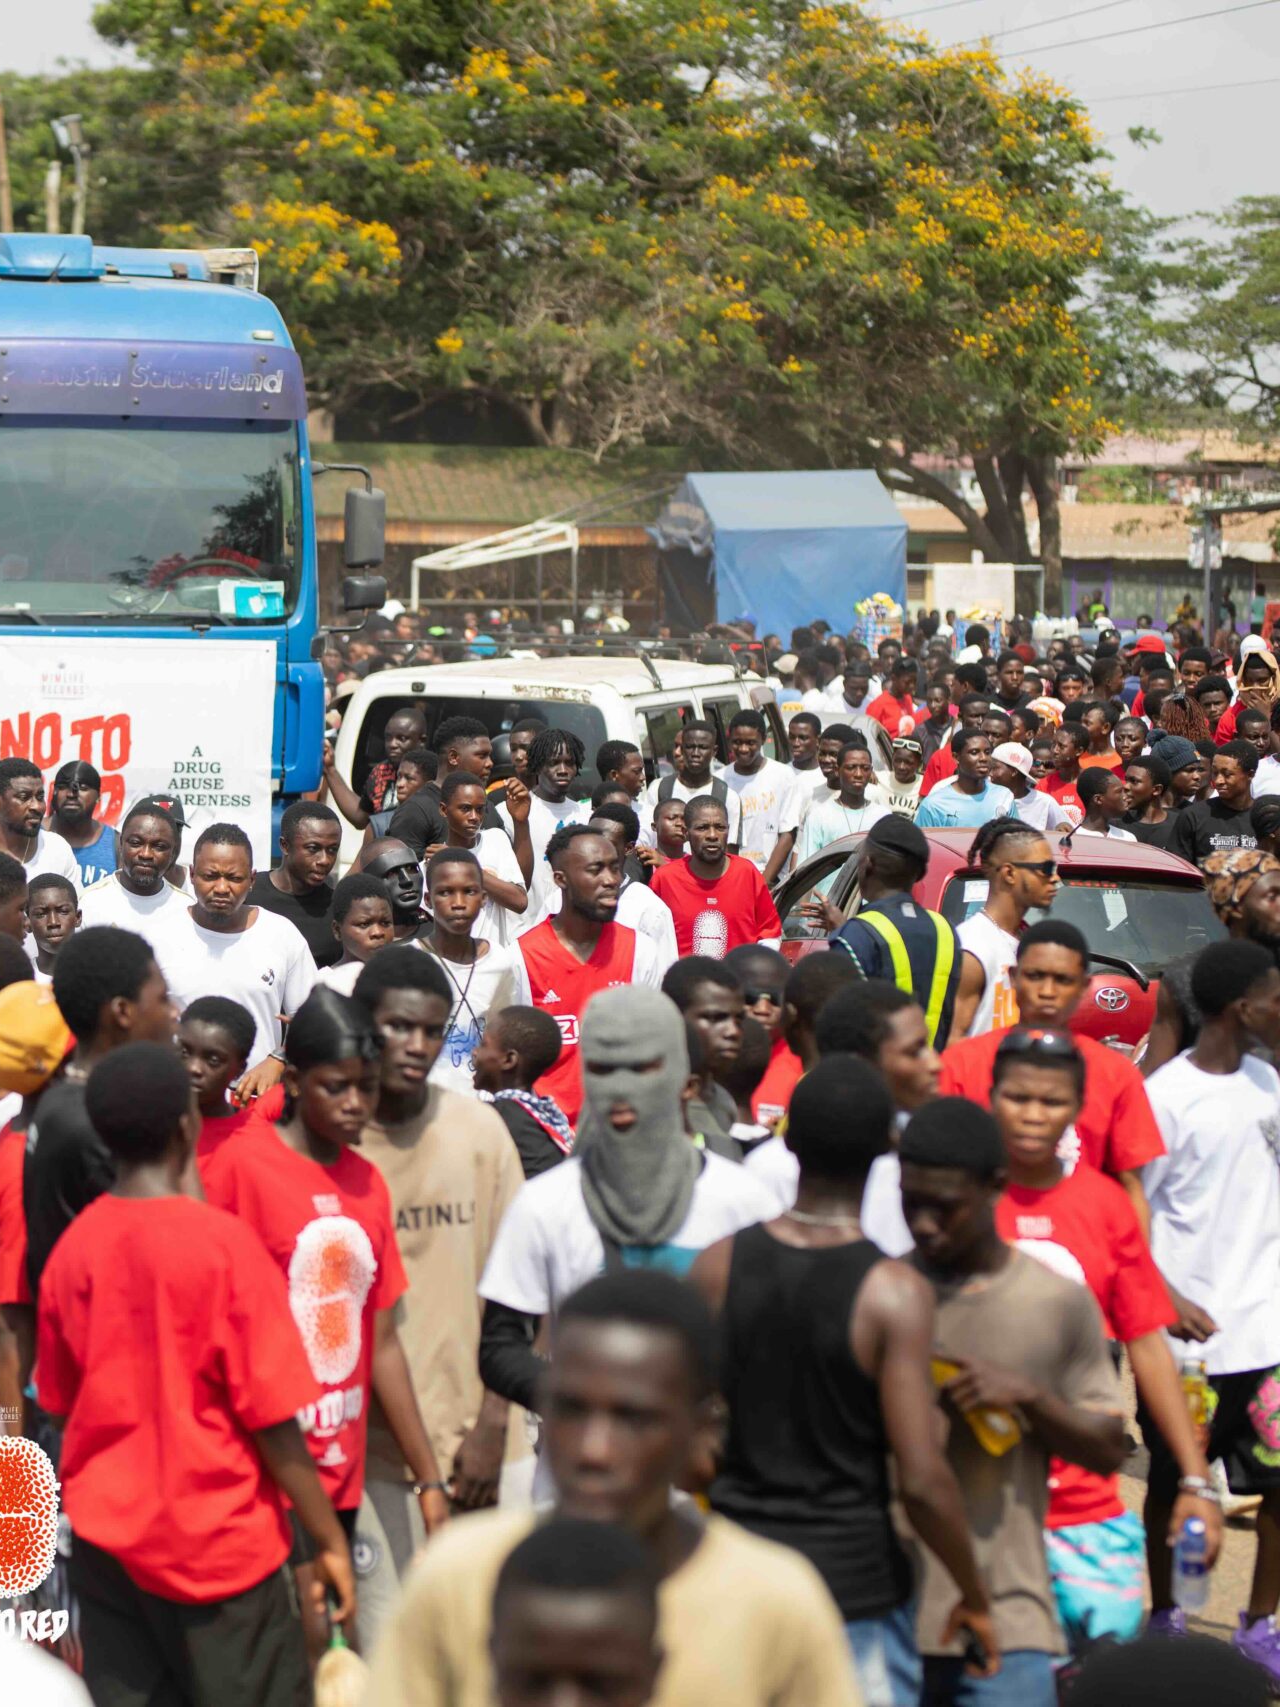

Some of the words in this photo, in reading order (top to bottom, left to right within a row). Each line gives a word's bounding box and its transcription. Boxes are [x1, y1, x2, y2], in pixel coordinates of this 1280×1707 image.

[0, 711, 62, 771] NO
[71, 713, 131, 771] TO
[192, 745, 203, 758] A
[173, 761, 221, 774] DRUG
[168, 778, 224, 790] ABUSE
[150, 793, 251, 807] RENESS
